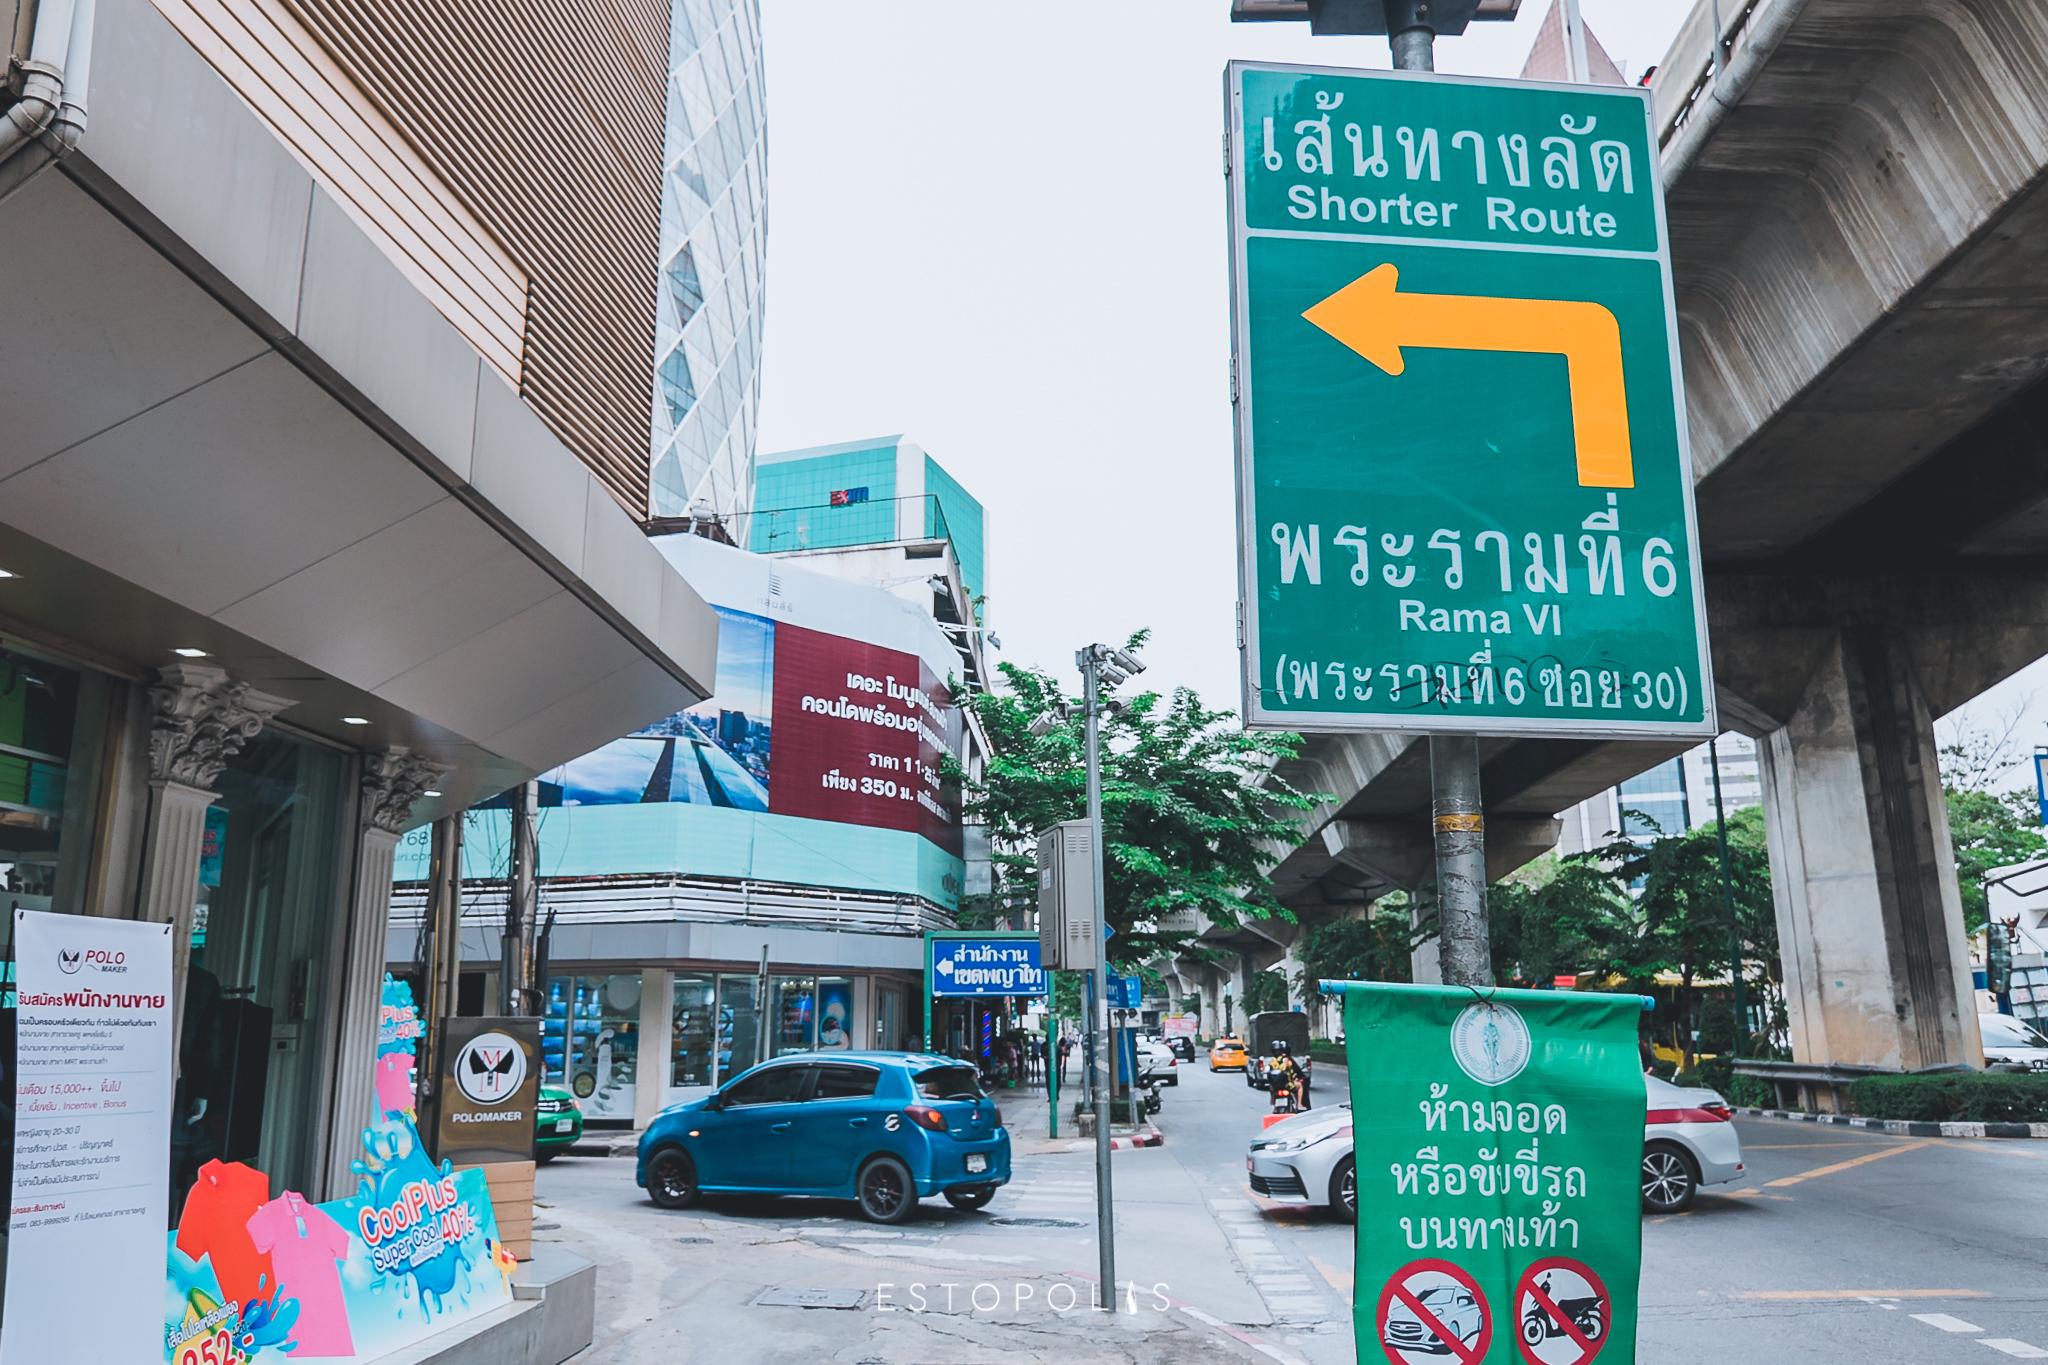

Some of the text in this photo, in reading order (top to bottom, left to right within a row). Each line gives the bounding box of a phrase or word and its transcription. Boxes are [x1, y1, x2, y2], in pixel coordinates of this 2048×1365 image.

[1262, 90, 1634, 195] เส้นทางลัด
[1287, 184, 1618, 238] Shorter Route
[1400, 599, 1563, 636] Rama VI
[846, 672, 884, 694] เดอะ
[868, 752, 899, 771] ราคา
[822, 768, 857, 792] เพียง
[860, 776, 897, 798] 350
[85, 950, 125, 964] POLO
[954, 943, 1029, 963] สำนักงาน
[101, 965, 128, 973] MAKER
[954, 963, 1042, 989] เขตพญาไท
[50, 1083, 92, 1095] 15,000++
[452, 1111, 522, 1123] POLOMAKER
[1419, 1082, 1567, 1135] ห้ามจอด
[1390, 1137, 1587, 1198] หรือขับขี่รถ
[359, 1178, 458, 1246] CoolPlus
[1399, 1199, 1579, 1250] บนทางเท้า
[372, 1237, 413, 1271] Super
[411, 1216, 441, 1249] Cool
[442, 1202, 475, 1244] 40%
